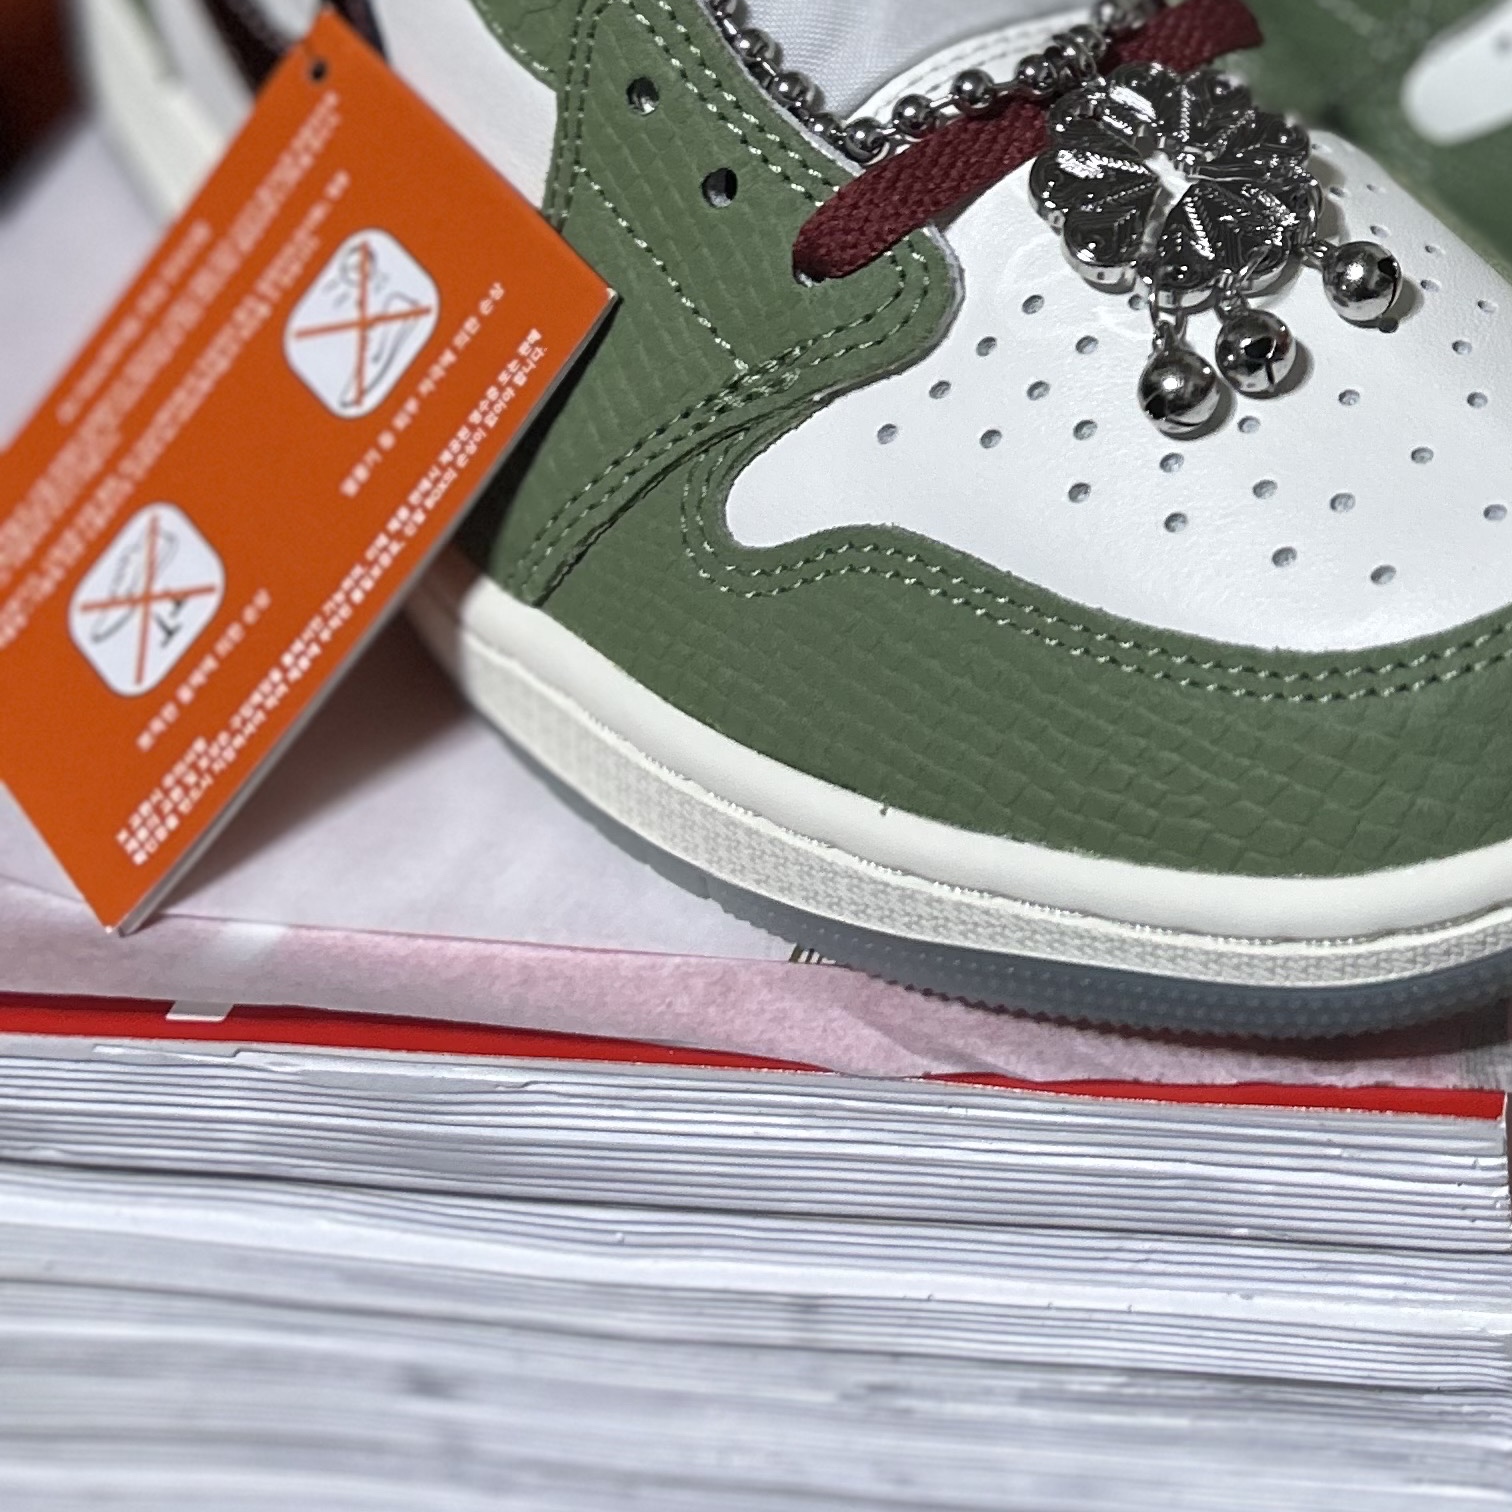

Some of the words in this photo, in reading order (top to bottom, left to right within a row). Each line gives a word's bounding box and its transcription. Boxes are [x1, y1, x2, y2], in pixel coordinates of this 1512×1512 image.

[497, 359, 520, 385] 또는
[450, 427, 486, 467] 손상이
[479, 386, 515, 428] 없어야
